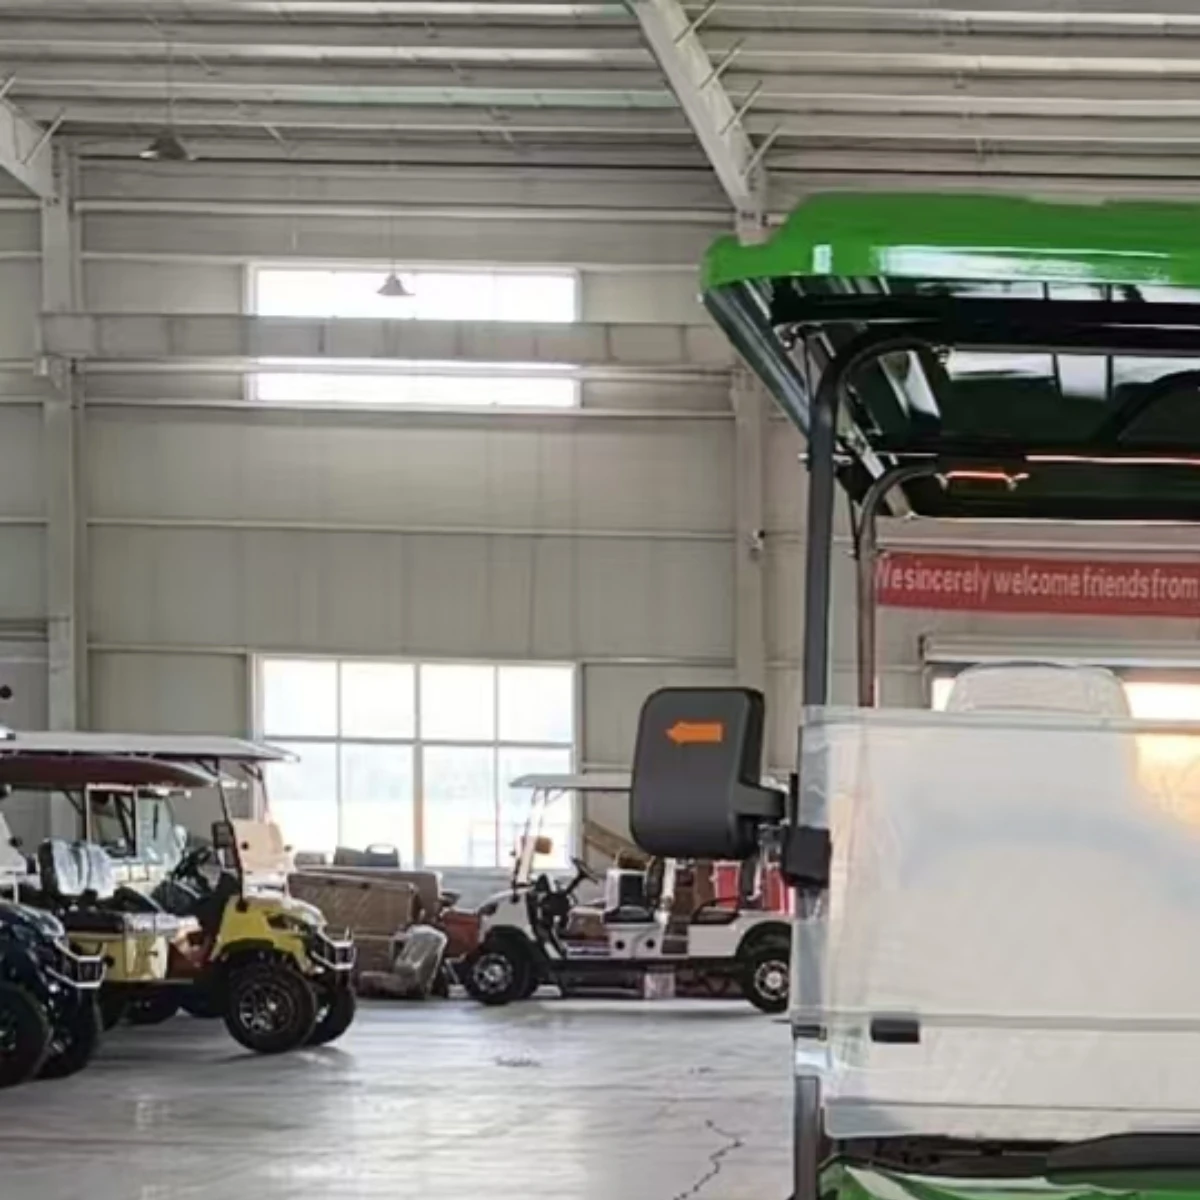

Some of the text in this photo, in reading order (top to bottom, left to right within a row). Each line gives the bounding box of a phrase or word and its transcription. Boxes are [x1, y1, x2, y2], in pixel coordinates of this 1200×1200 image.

[904, 560, 991, 603] sincerely
[993, 564, 1081, 598] welcome
[1083, 566, 1149, 599] friends
[1151, 568, 1199, 599] from
